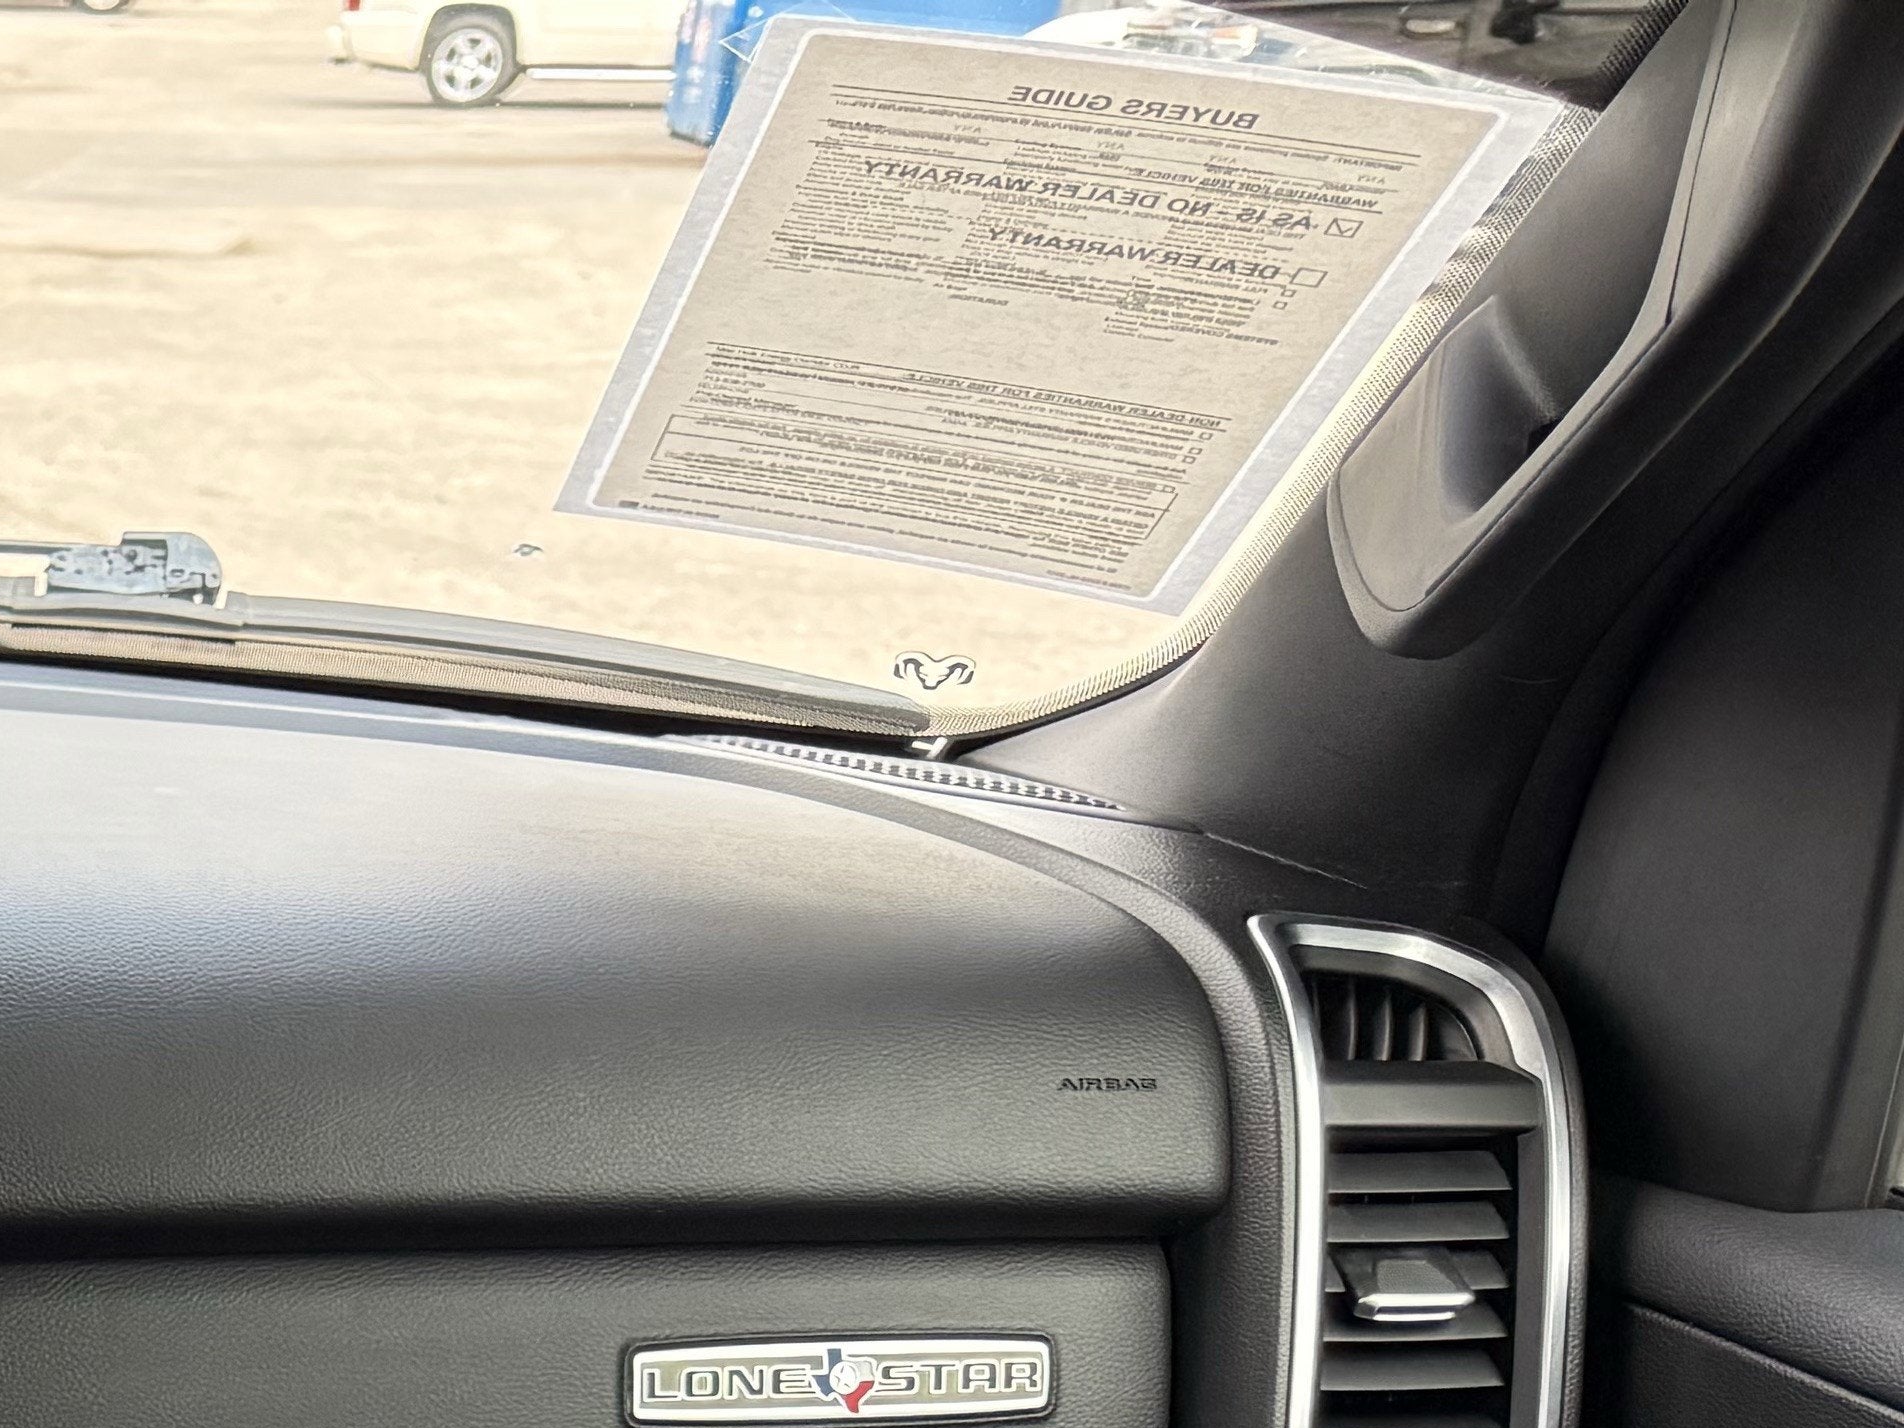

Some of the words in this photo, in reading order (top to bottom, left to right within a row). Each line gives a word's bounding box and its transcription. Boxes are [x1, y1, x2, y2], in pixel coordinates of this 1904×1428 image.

[1056, 1076, 1160, 1093] AIRBAG
[643, 1362, 819, 1402] LONE
[874, 1358, 1044, 1397] STAR
